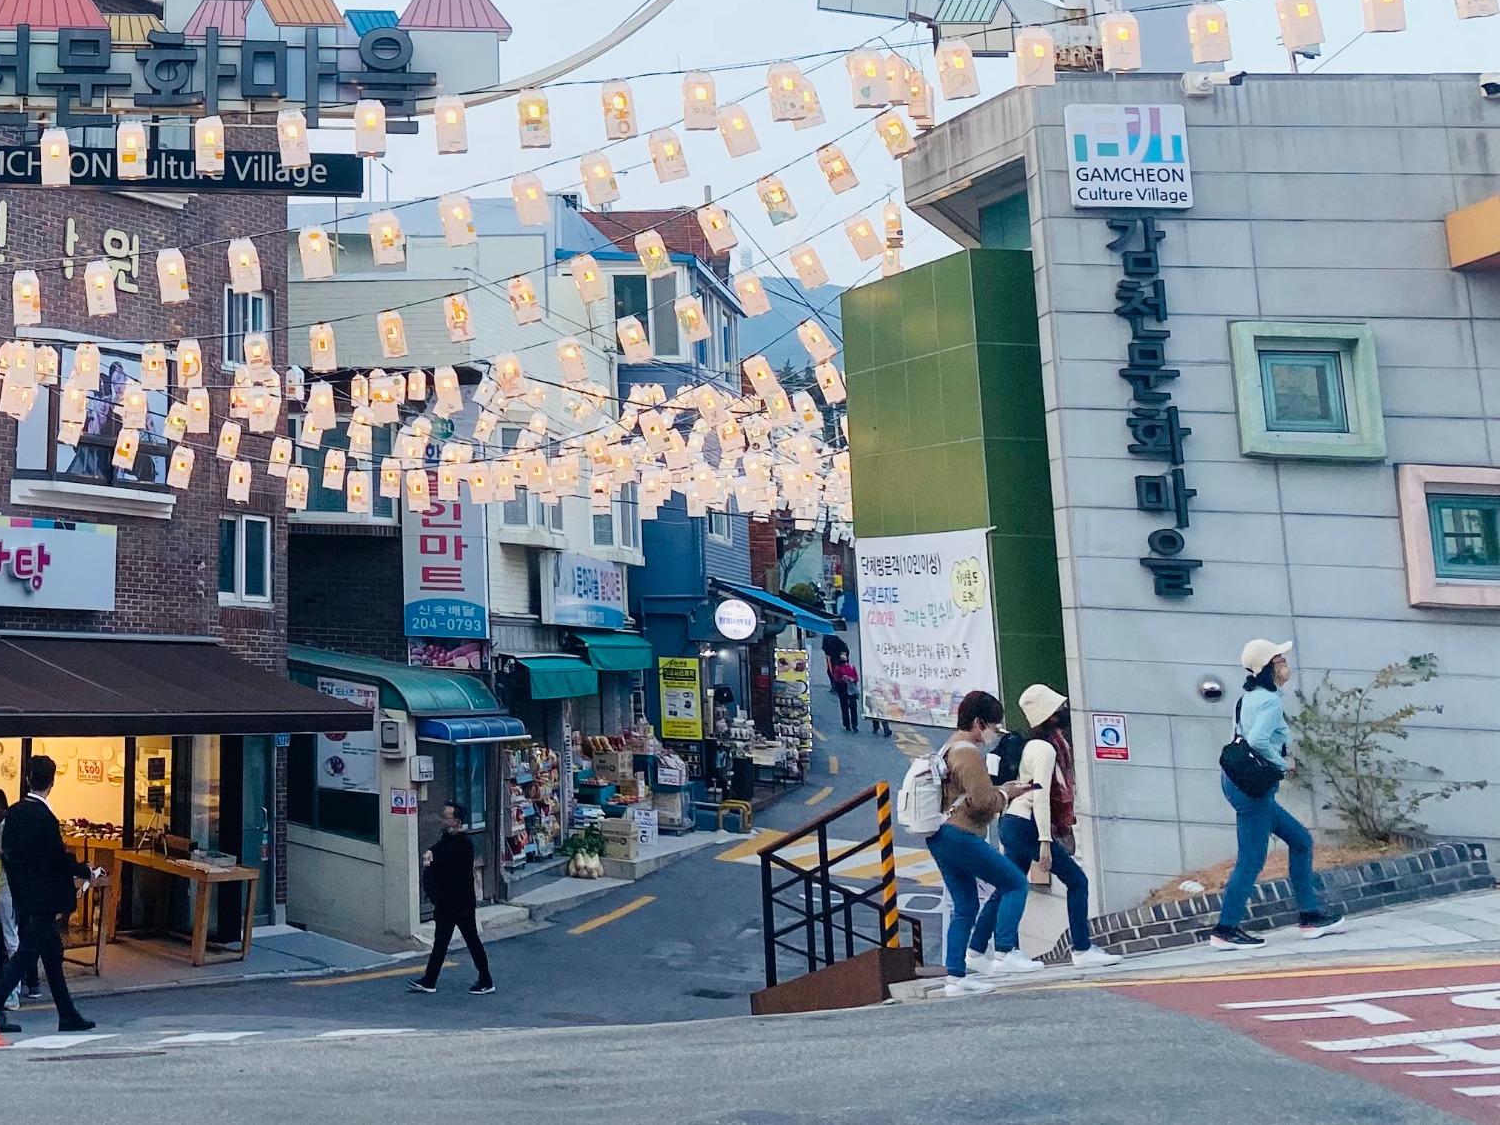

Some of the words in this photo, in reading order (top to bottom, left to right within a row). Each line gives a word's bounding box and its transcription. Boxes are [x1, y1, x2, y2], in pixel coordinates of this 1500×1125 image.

[231, 155, 328, 187] Village
[1076, 167, 1185, 183] GAMCHEON
[1077, 186, 1134, 201] Culture
[1136, 187, 1189, 203] Village
[1105, 216, 1203, 596] 감천문화마을
[418, 604, 476, 618] 신속배달
[411, 617, 482, 632] 204-0793
